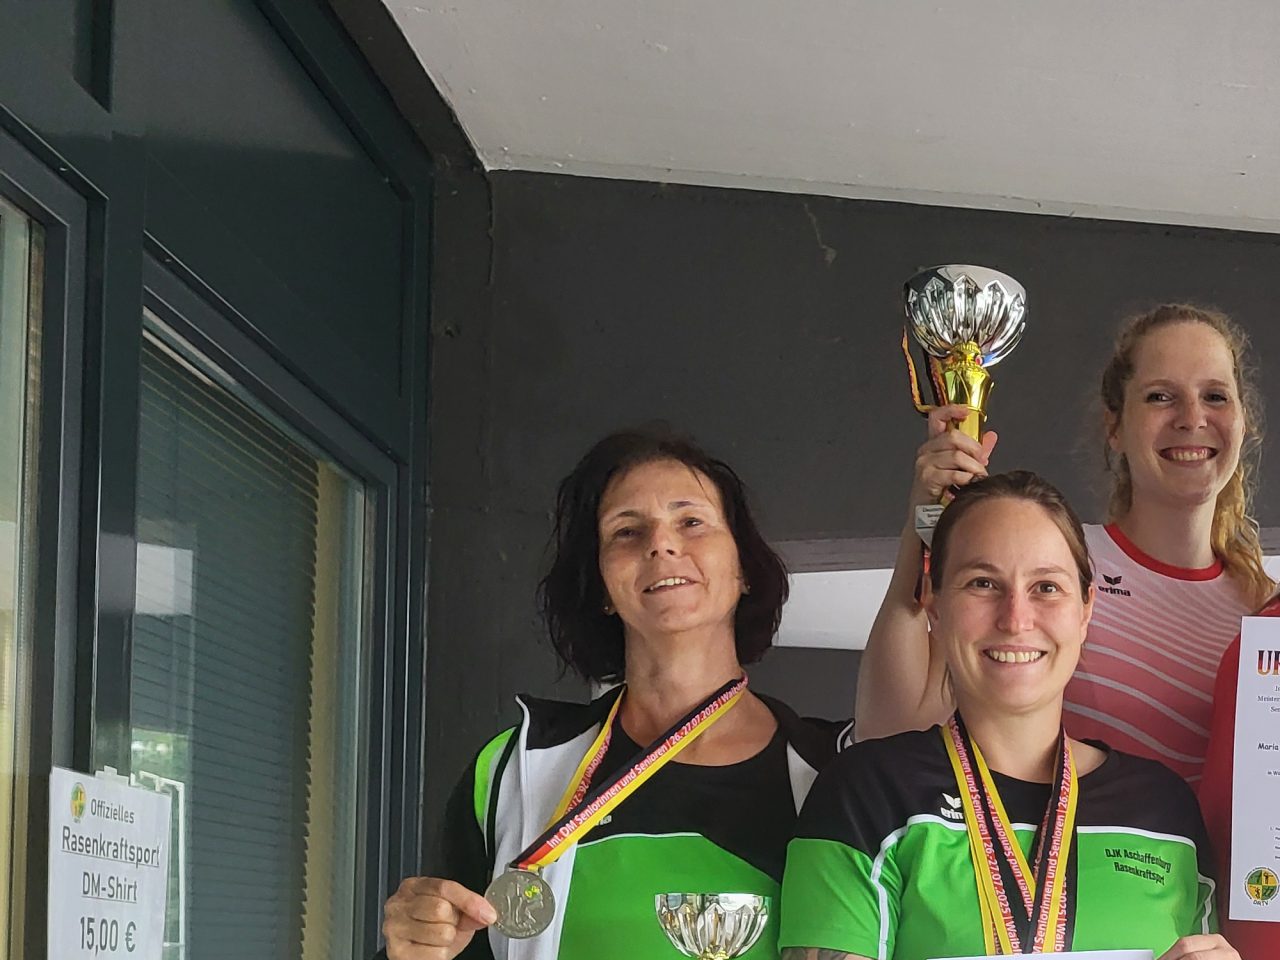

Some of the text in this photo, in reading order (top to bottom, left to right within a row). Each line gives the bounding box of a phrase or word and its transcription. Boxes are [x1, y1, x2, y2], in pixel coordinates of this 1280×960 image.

[1098, 586, 1131, 596] erima
[559, 820, 578, 836] DM
[575, 784, 621, 824] Seniorinnen
[620, 768, 637, 786] und
[635, 744, 668, 774] Senioren
[966, 774, 979, 793] und
[90, 798, 134, 824] Offizielles
[972, 794, 991, 835] Senioren
[62, 826, 160, 868] Rasenkraftsport
[991, 816, 1013, 856] Senioren
[1049, 815, 1064, 857] Senioren
[1007, 858, 1023, 877] und
[1048, 858, 1058, 878] und
[1105, 849, 1171, 873] DJK Aschaffenburg
[1114, 862, 1164, 885] Rasenkraftsport
[82, 872, 137, 901] DM-Shirt
[1034, 882, 1054, 944] Seniorinnen
[80, 917, 136, 956] 15,00 €
